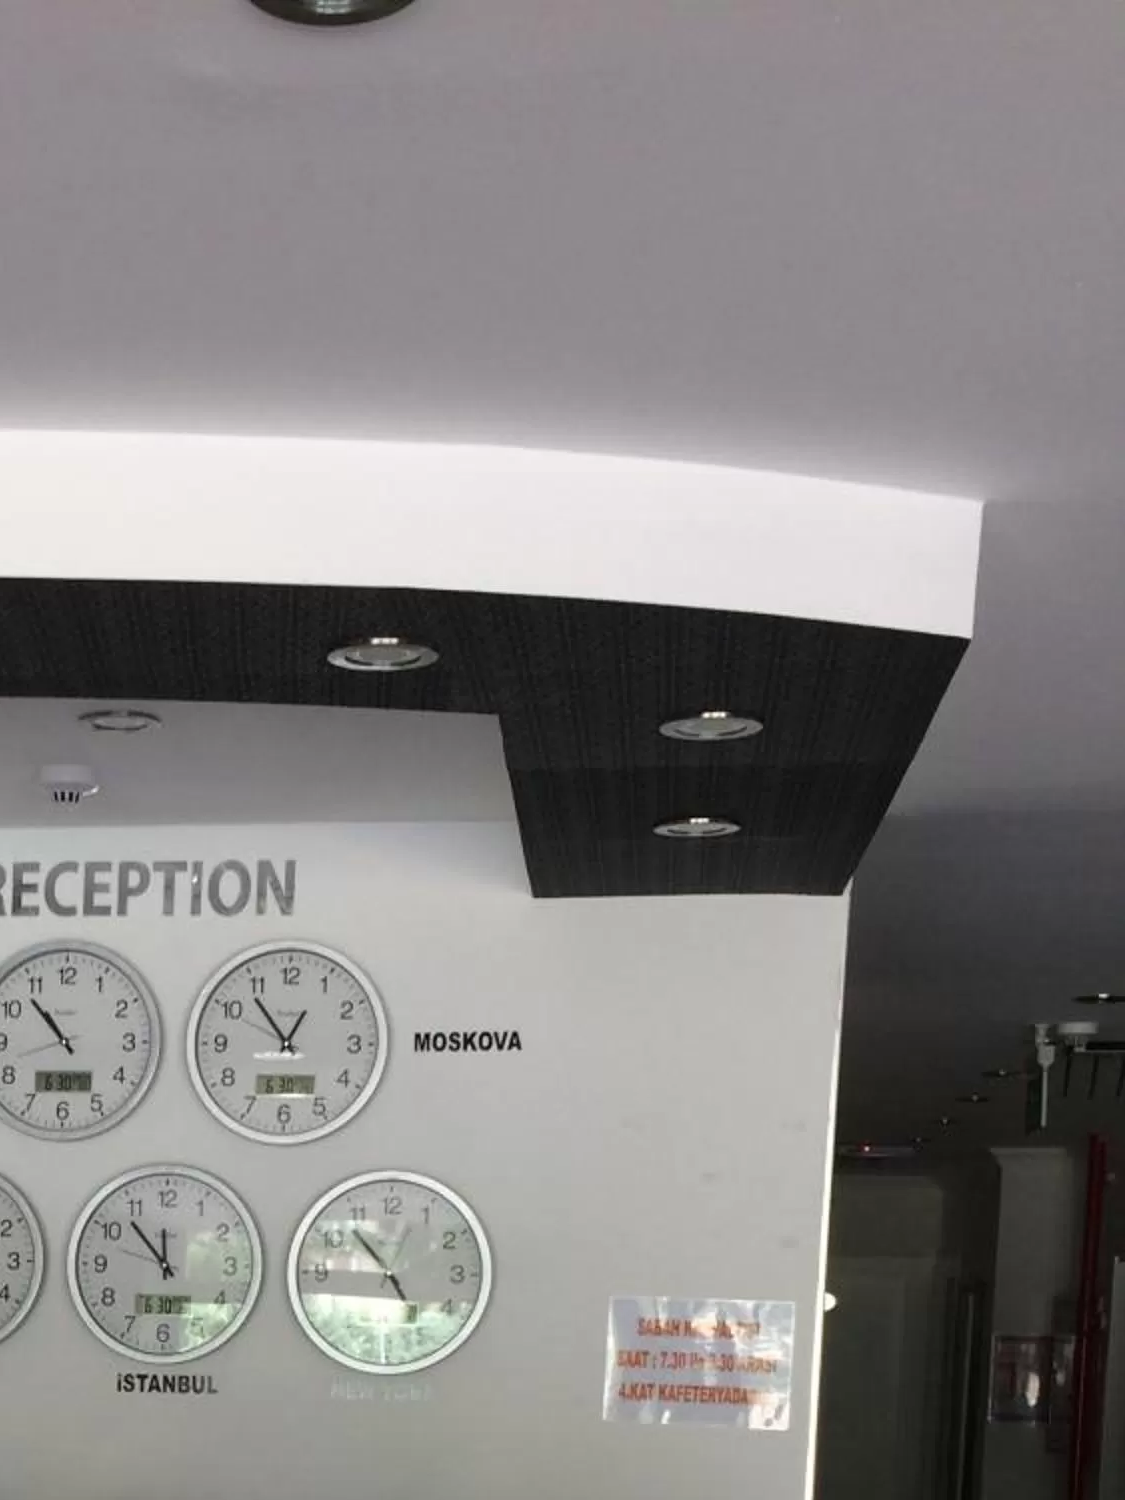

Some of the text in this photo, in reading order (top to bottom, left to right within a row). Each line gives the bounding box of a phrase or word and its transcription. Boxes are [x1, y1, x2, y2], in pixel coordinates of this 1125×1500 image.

[29, 977, 42, 993] 11
[59, 967, 76, 985] 12
[96, 977, 103, 992] 1
[282, 967, 300, 985] 12
[321, 976, 327, 993] 1
[251, 977, 264, 994] 11
[3, 1001, 21, 1019] 10
[115, 1000, 127, 1018] 2
[223, 1001, 242, 1019] 10
[341, 1001, 353, 1019] 2
[123, 1033, 135, 1051] 3
[214, 1034, 227, 1052] 9
[347, 1035, 361, 1054] 3
[414, 1031, 522, 1052] MOSKOVA
[3, 1066, 15, 1084] 8
[113, 1067, 124, 1084] 4
[222, 1068, 235, 1086] 8
[337, 1069, 349, 1086] 4
[25, 1094, 35, 1111] 7
[57, 1102, 69, 1120] 6
[91, 1094, 103, 1112] 5
[245, 1097, 256, 1114] 7
[313, 1098, 325, 1115] 5
[278, 1105, 290, 1124] 6
[127, 1200, 142, 1216] 11
[159, 1190, 177, 1208] 12
[383, 1198, 402, 1214] 12
[197, 1201, 203, 1216] 1
[350, 1208, 365, 1220] 11
[422, 1208, 429, 1223] 1
[0, 1220, 12, 1236] 2
[102, 1222, 121, 1240] 10
[217, 1224, 229, 1242] 2
[443, 1232, 456, 1249] 2
[7, 1252, 20, 1270] 3
[95, 1255, 107, 1273] 9
[223, 1257, 237, 1276] 3
[315, 1264, 328, 1282] 9
[451, 1265, 464, 1283] 3
[0, 1284, 10, 1302] 4
[101, 1288, 115, 1306] 8
[214, 1291, 225, 1304] 4
[125, 1316, 135, 1333] 7
[157, 1324, 170, 1342] 6
